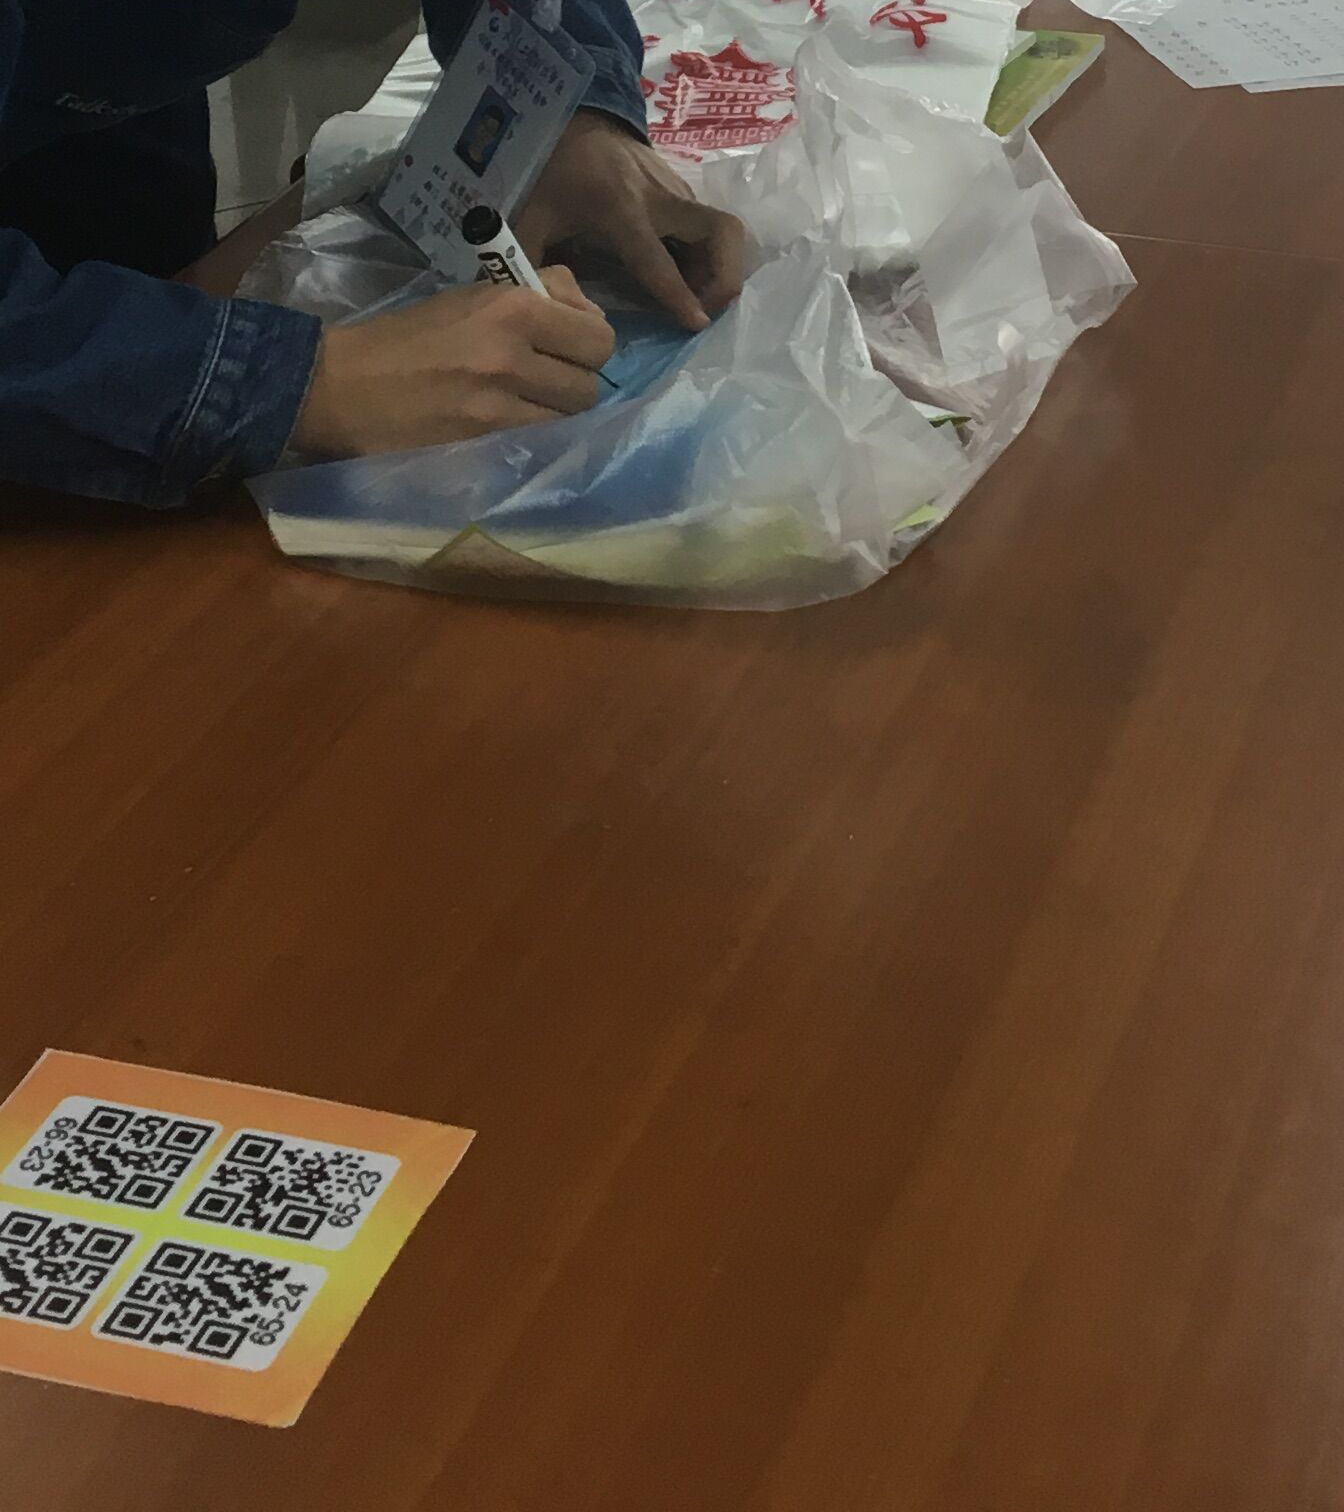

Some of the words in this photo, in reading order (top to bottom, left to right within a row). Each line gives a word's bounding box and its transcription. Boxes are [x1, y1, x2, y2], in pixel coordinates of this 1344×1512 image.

[20, 1117, 77, 1172] 66-23
[327, 1170, 381, 1228] 65-23
[250, 1281, 308, 1346] 65-24
